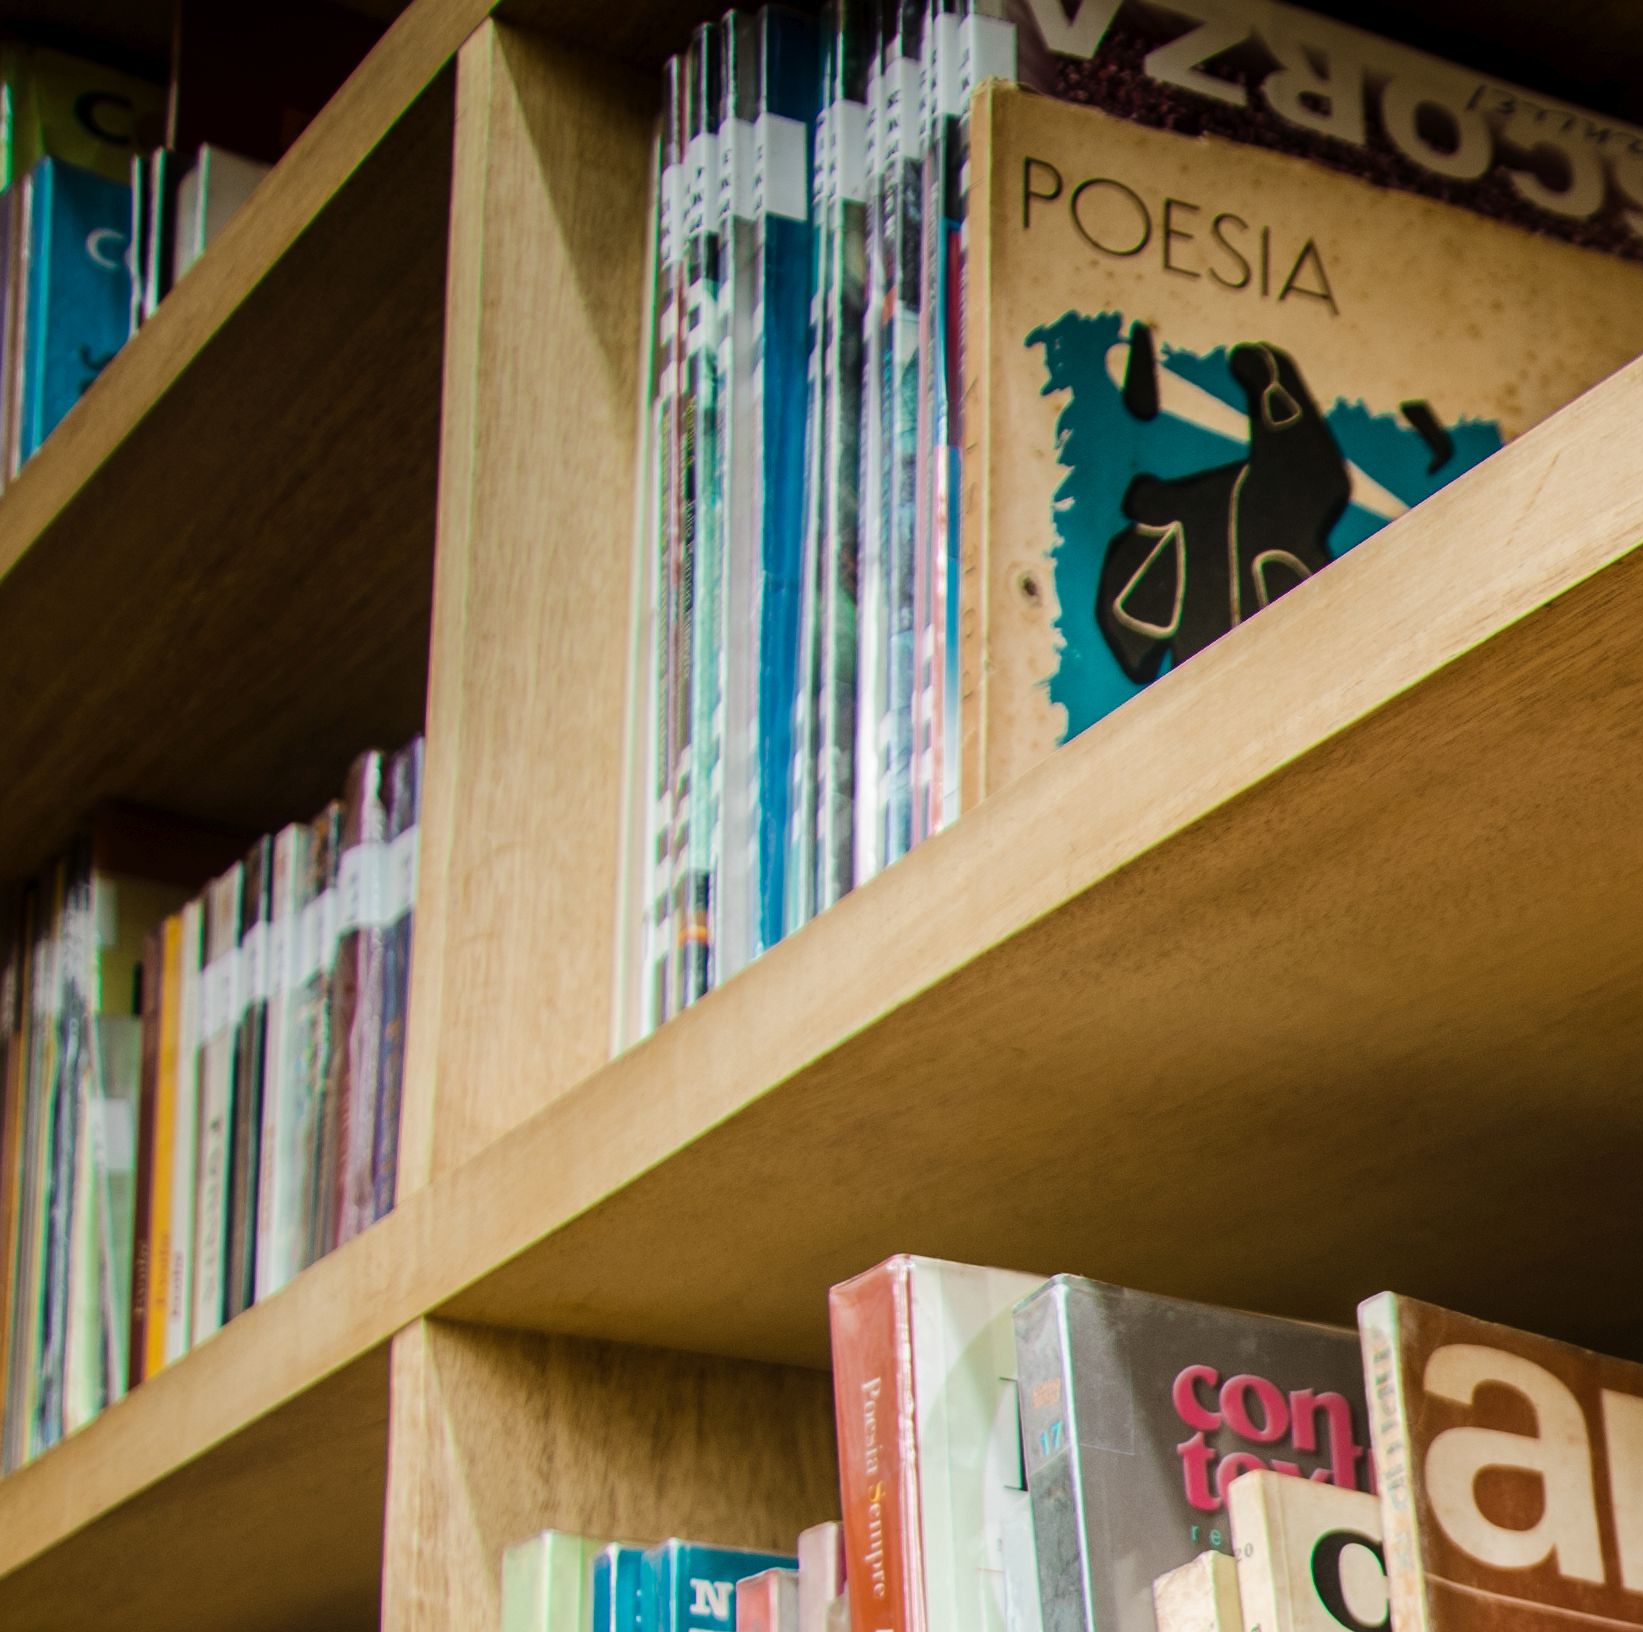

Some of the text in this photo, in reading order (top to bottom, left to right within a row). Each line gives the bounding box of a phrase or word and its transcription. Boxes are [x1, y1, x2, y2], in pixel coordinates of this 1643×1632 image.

[1022, 156, 1341, 317] POESIA
[858, 1376, 883, 1477] Poesia
[1039, 1419, 1064, 1457] 17
[860, 1482, 889, 1600] Sempre
